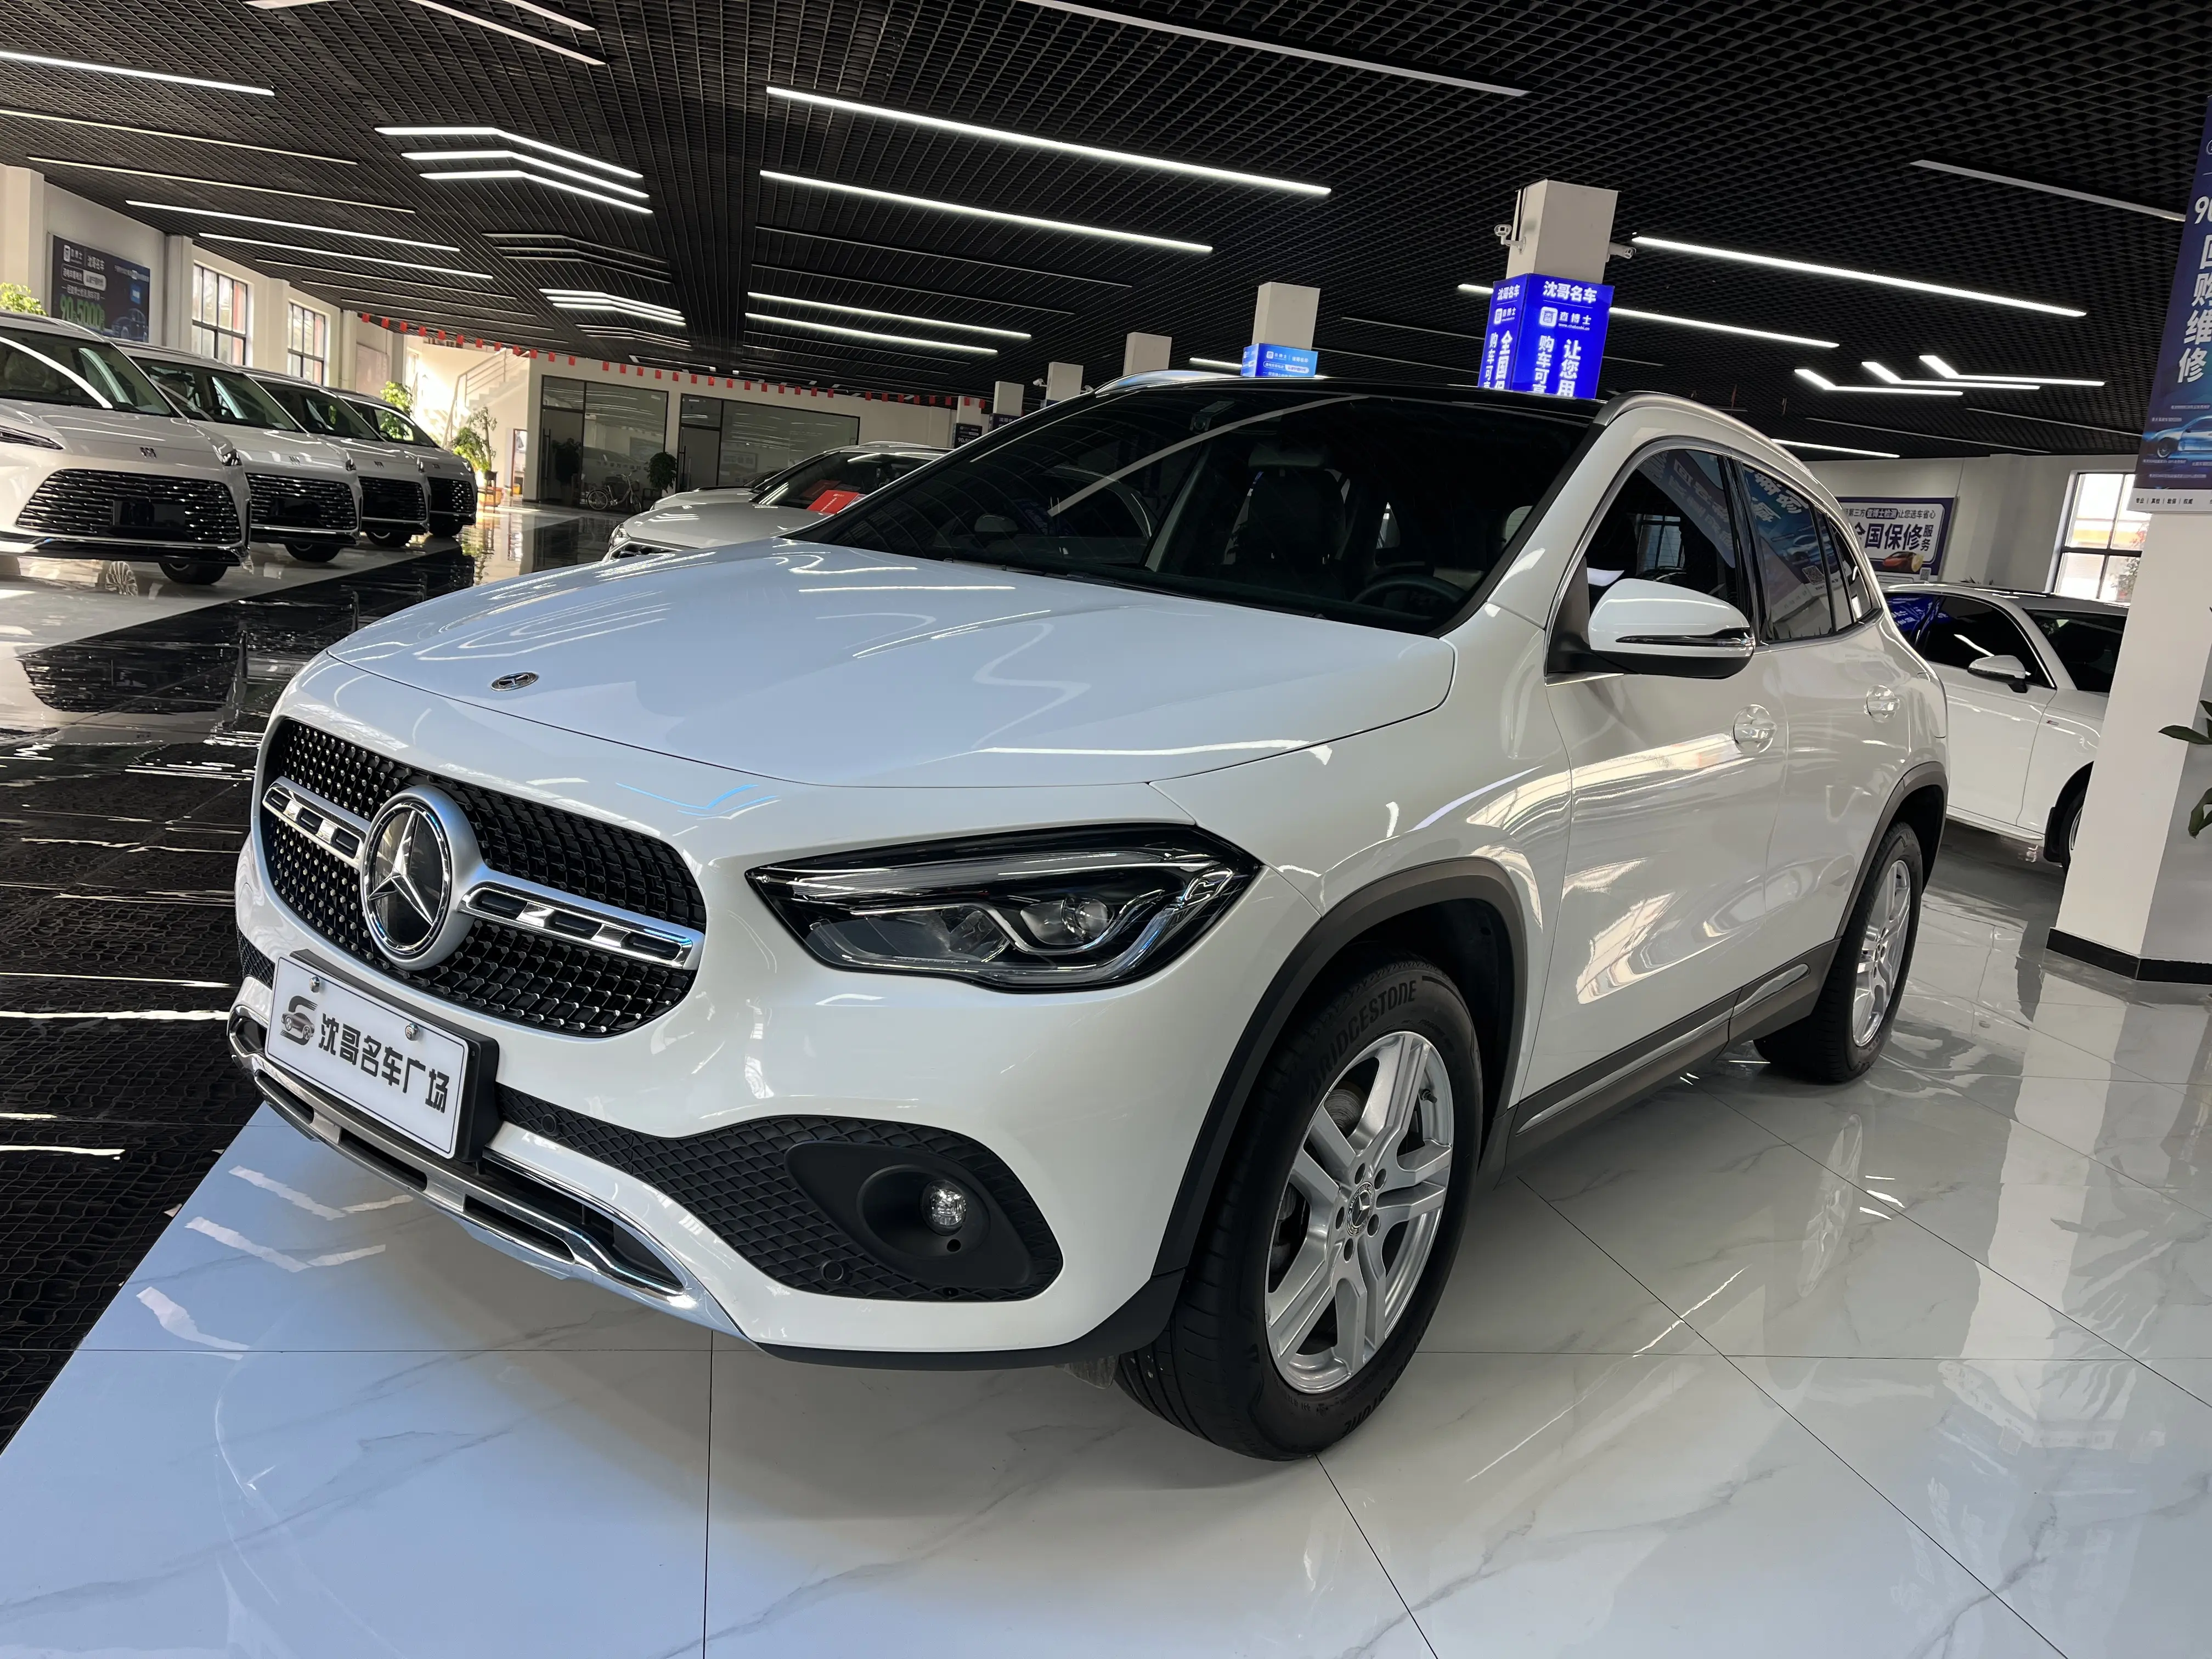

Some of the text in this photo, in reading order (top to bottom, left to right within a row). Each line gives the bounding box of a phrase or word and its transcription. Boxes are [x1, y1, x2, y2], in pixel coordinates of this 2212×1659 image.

[1497, 284, 1521, 301] 沈哥名车
[1543, 280, 1597, 303] 沈哥名车
[1559, 311, 1592, 325] 查博士
[1557, 338, 1582, 397] 让您用
[318, 1013, 449, 1113] 沈哥名车广场
